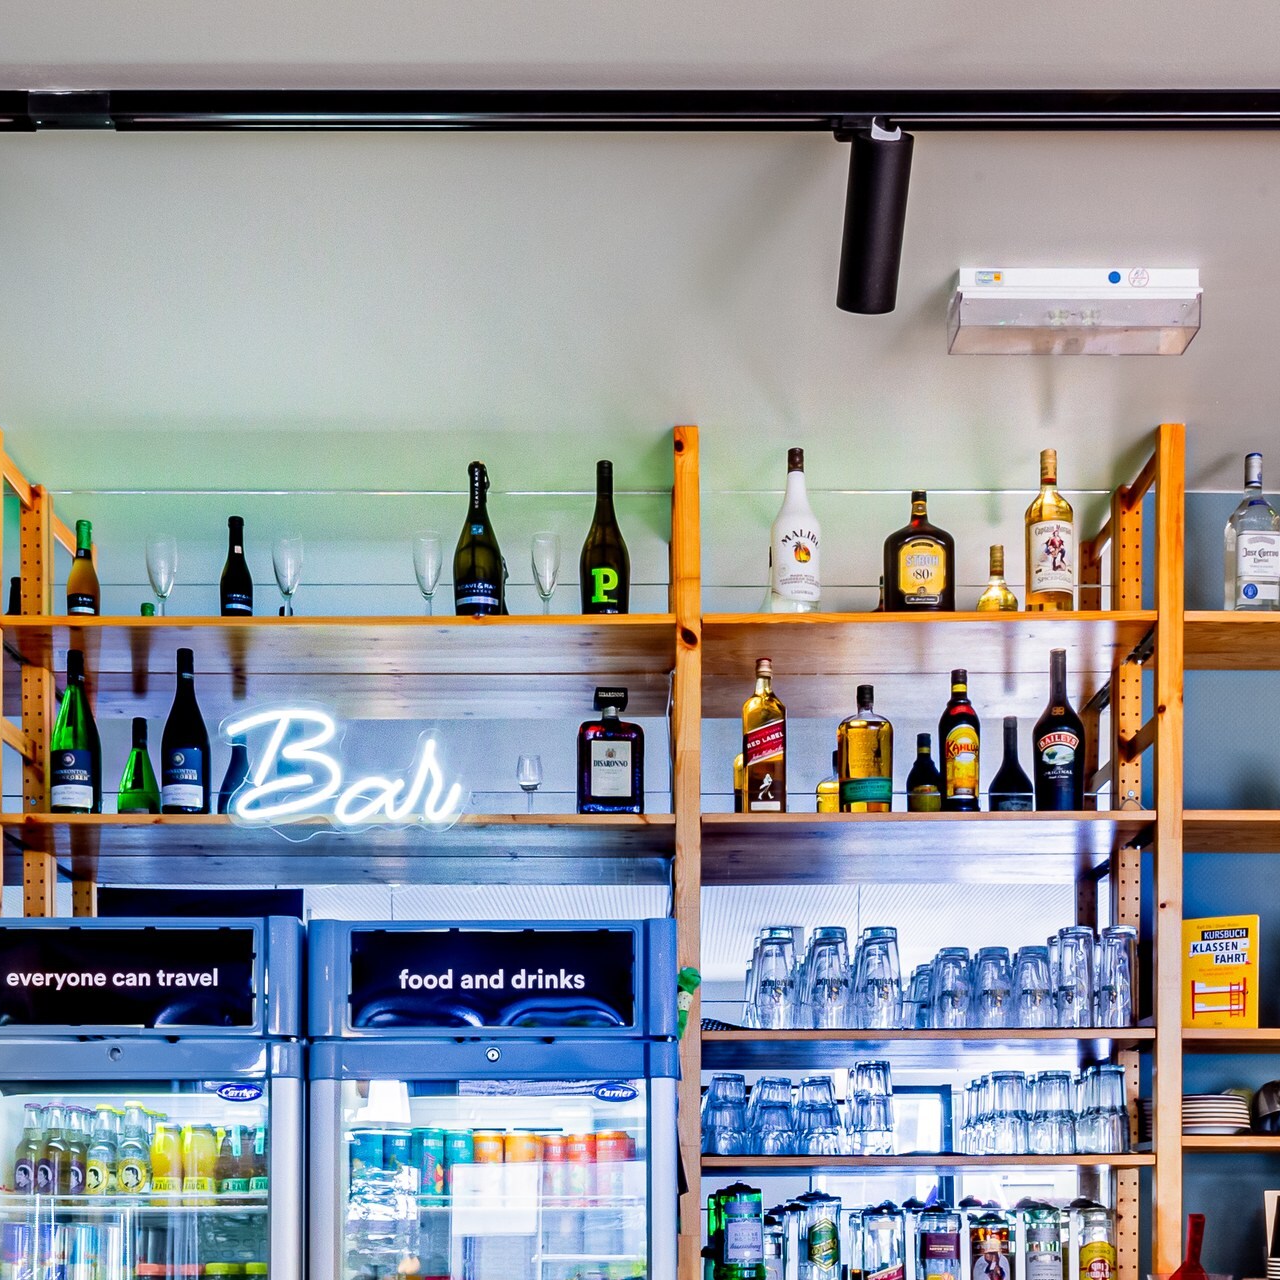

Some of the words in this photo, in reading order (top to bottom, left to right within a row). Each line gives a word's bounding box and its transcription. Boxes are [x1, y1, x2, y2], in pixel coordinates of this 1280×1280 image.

[915, 569, 930, 579] 80
[762, 731, 784, 743] LABEL
[1039, 733, 1079, 749] BAILEYS
[227, 710, 462, 823] Bar
[593, 759, 628, 768] DISARONNO
[1204, 929, 1246, 940] KURSBUCH
[1192, 941, 1238, 953] KLASSEN
[1215, 952, 1247, 963] FAHRT
[6, 969, 107, 991] everyone
[112, 970, 152, 988] can
[156, 968, 219, 988] travel
[399, 968, 453, 990] food
[460, 968, 504, 990] and
[510, 968, 586, 990] drinks
[222, 1086, 260, 1098] Carrier
[598, 1088, 634, 1098] Carrier
